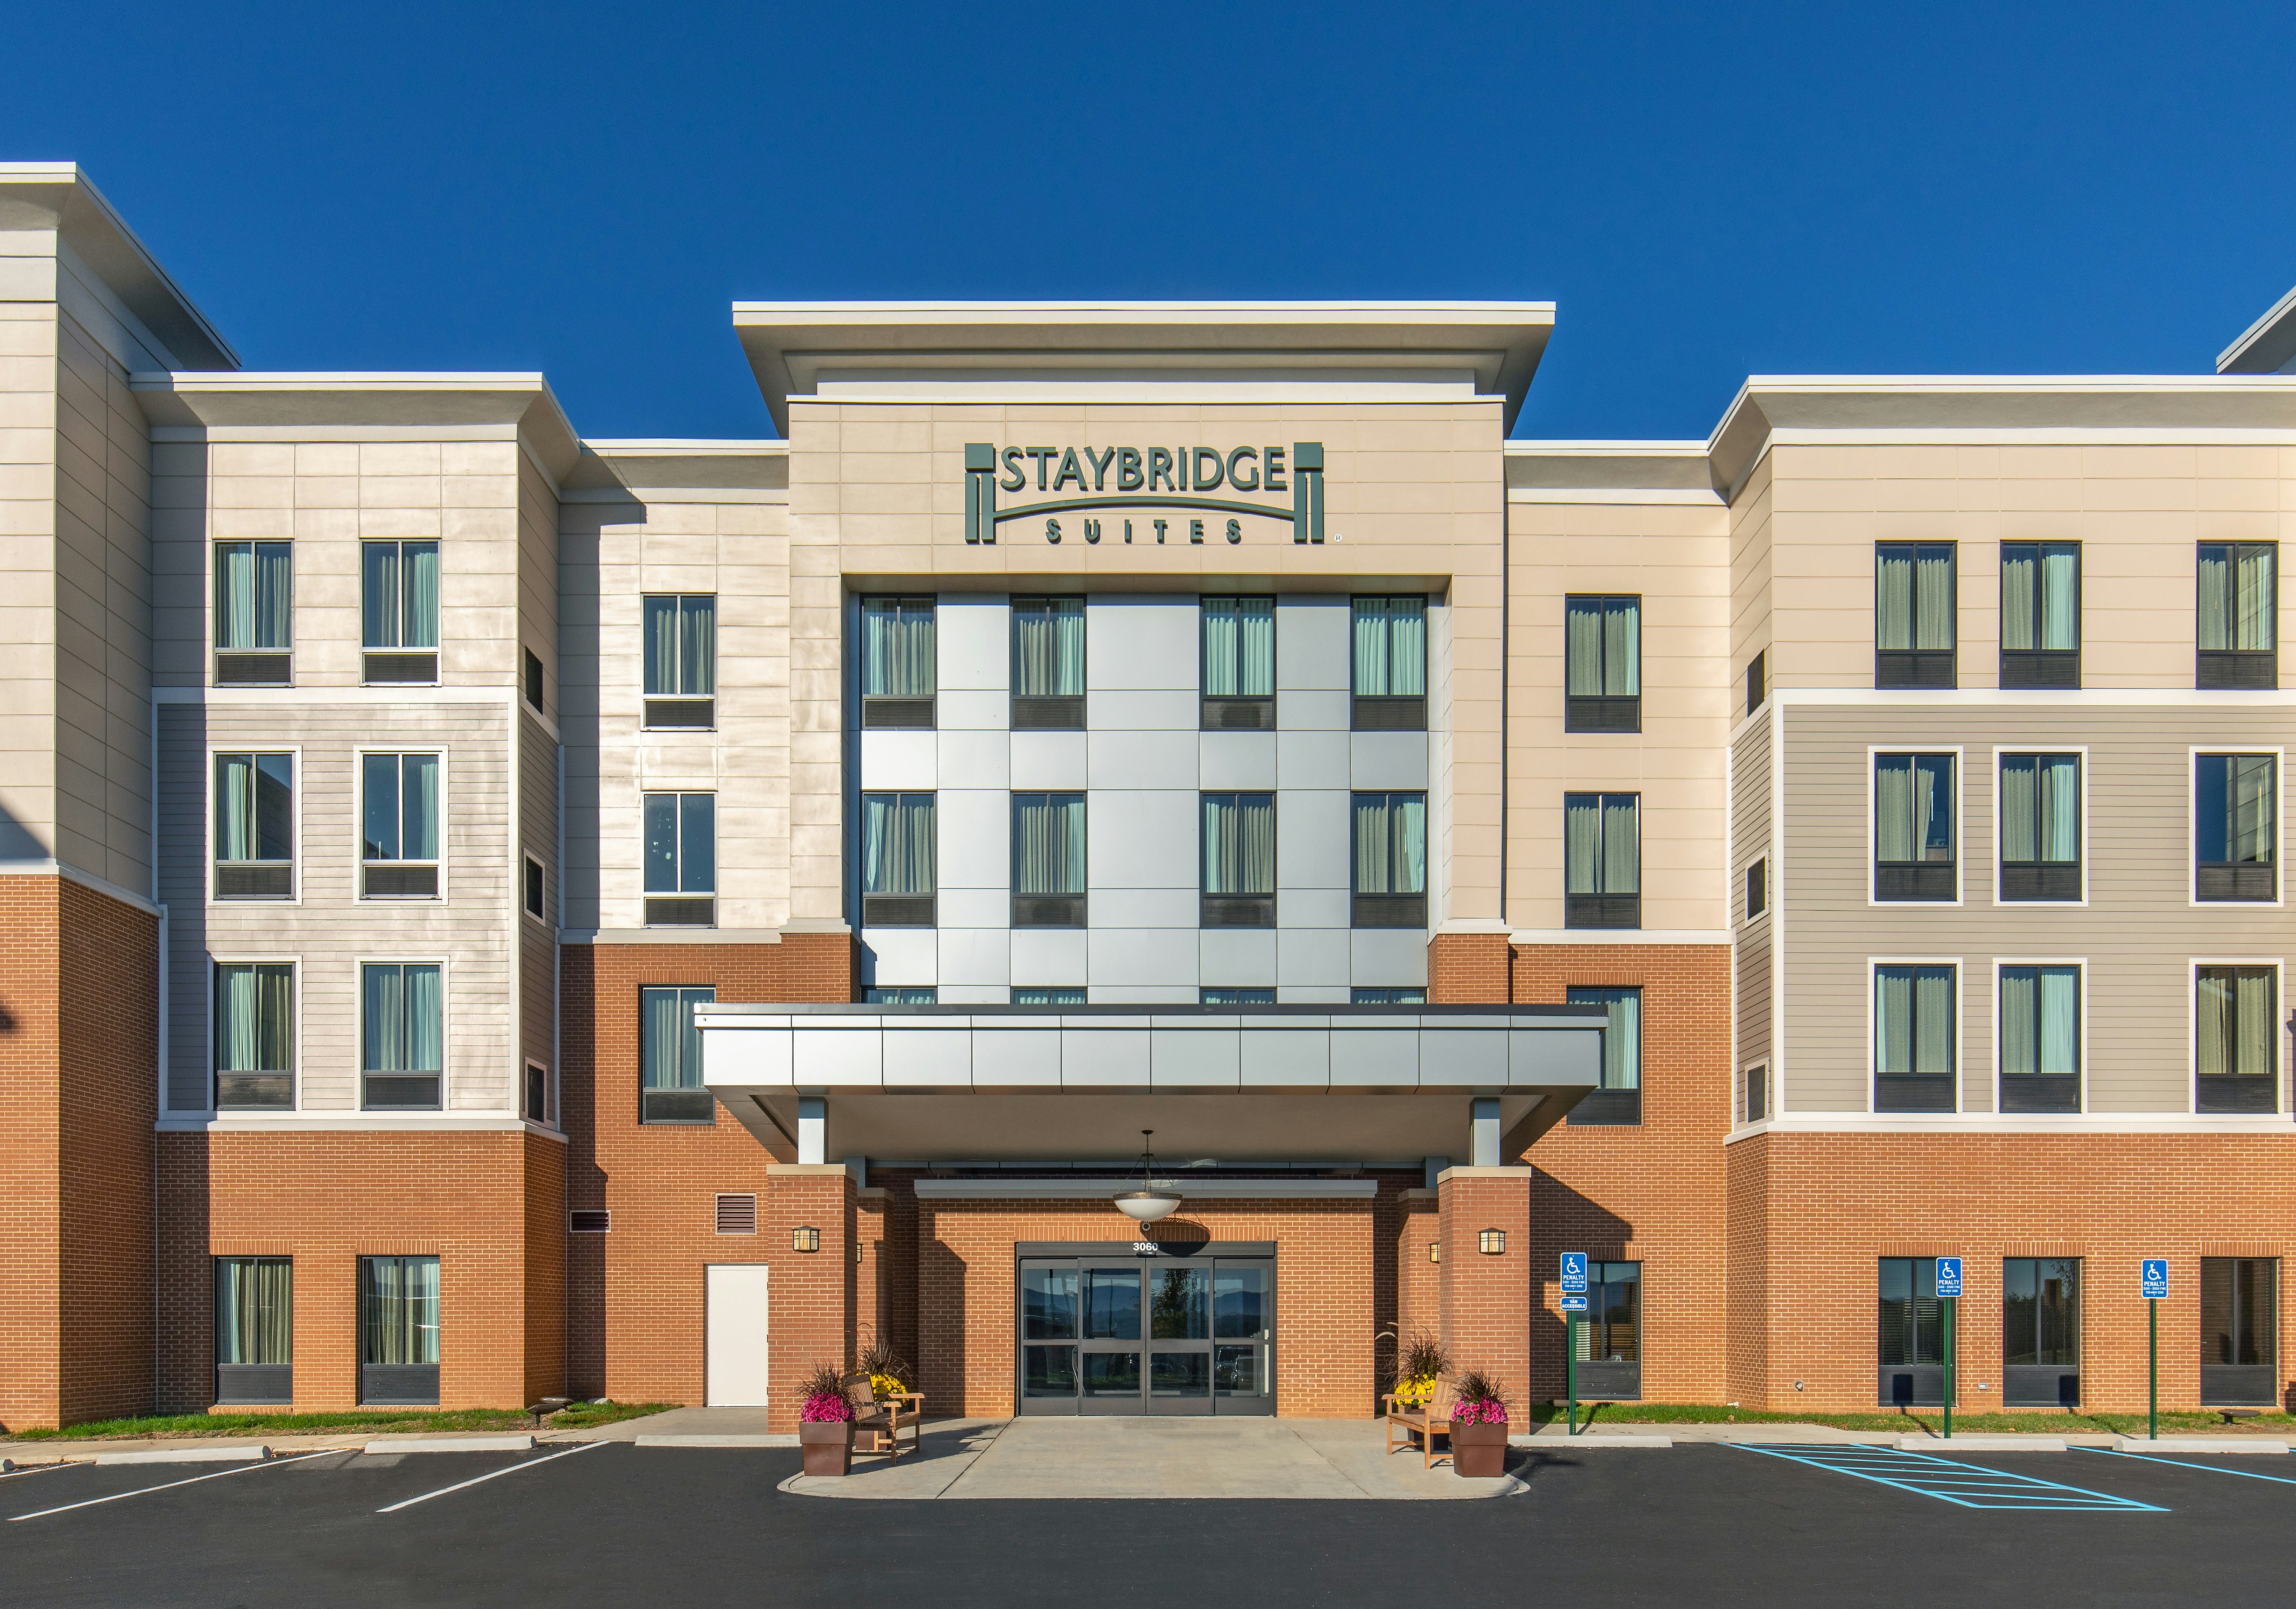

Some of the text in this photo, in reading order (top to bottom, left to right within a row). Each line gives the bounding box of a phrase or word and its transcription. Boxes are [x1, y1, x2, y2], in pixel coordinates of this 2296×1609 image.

[1000, 445, 1287, 492] STAYBRIDGE
[1045, 518, 1241, 544] SUITES
[1133, 1242, 1159, 1251] 3060
